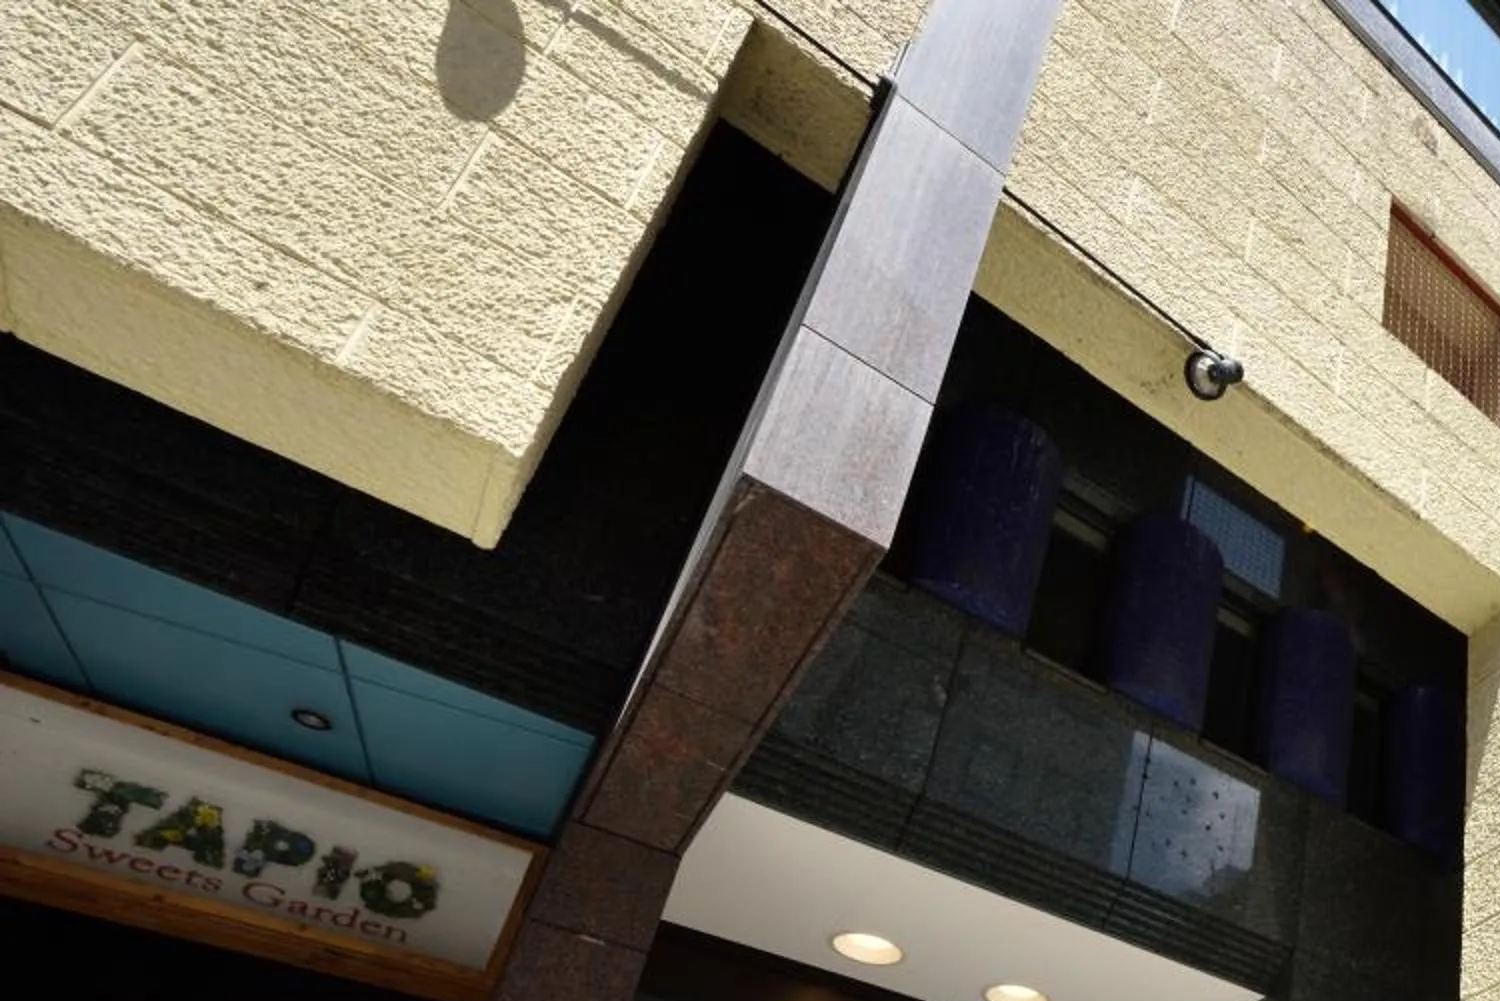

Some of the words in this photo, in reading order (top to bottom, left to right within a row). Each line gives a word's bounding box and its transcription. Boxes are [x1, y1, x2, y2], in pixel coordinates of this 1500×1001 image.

[46, 827, 223, 894] Sweets
[241, 881, 409, 943] Garden
[75, 768, 440, 919] TAPIO
